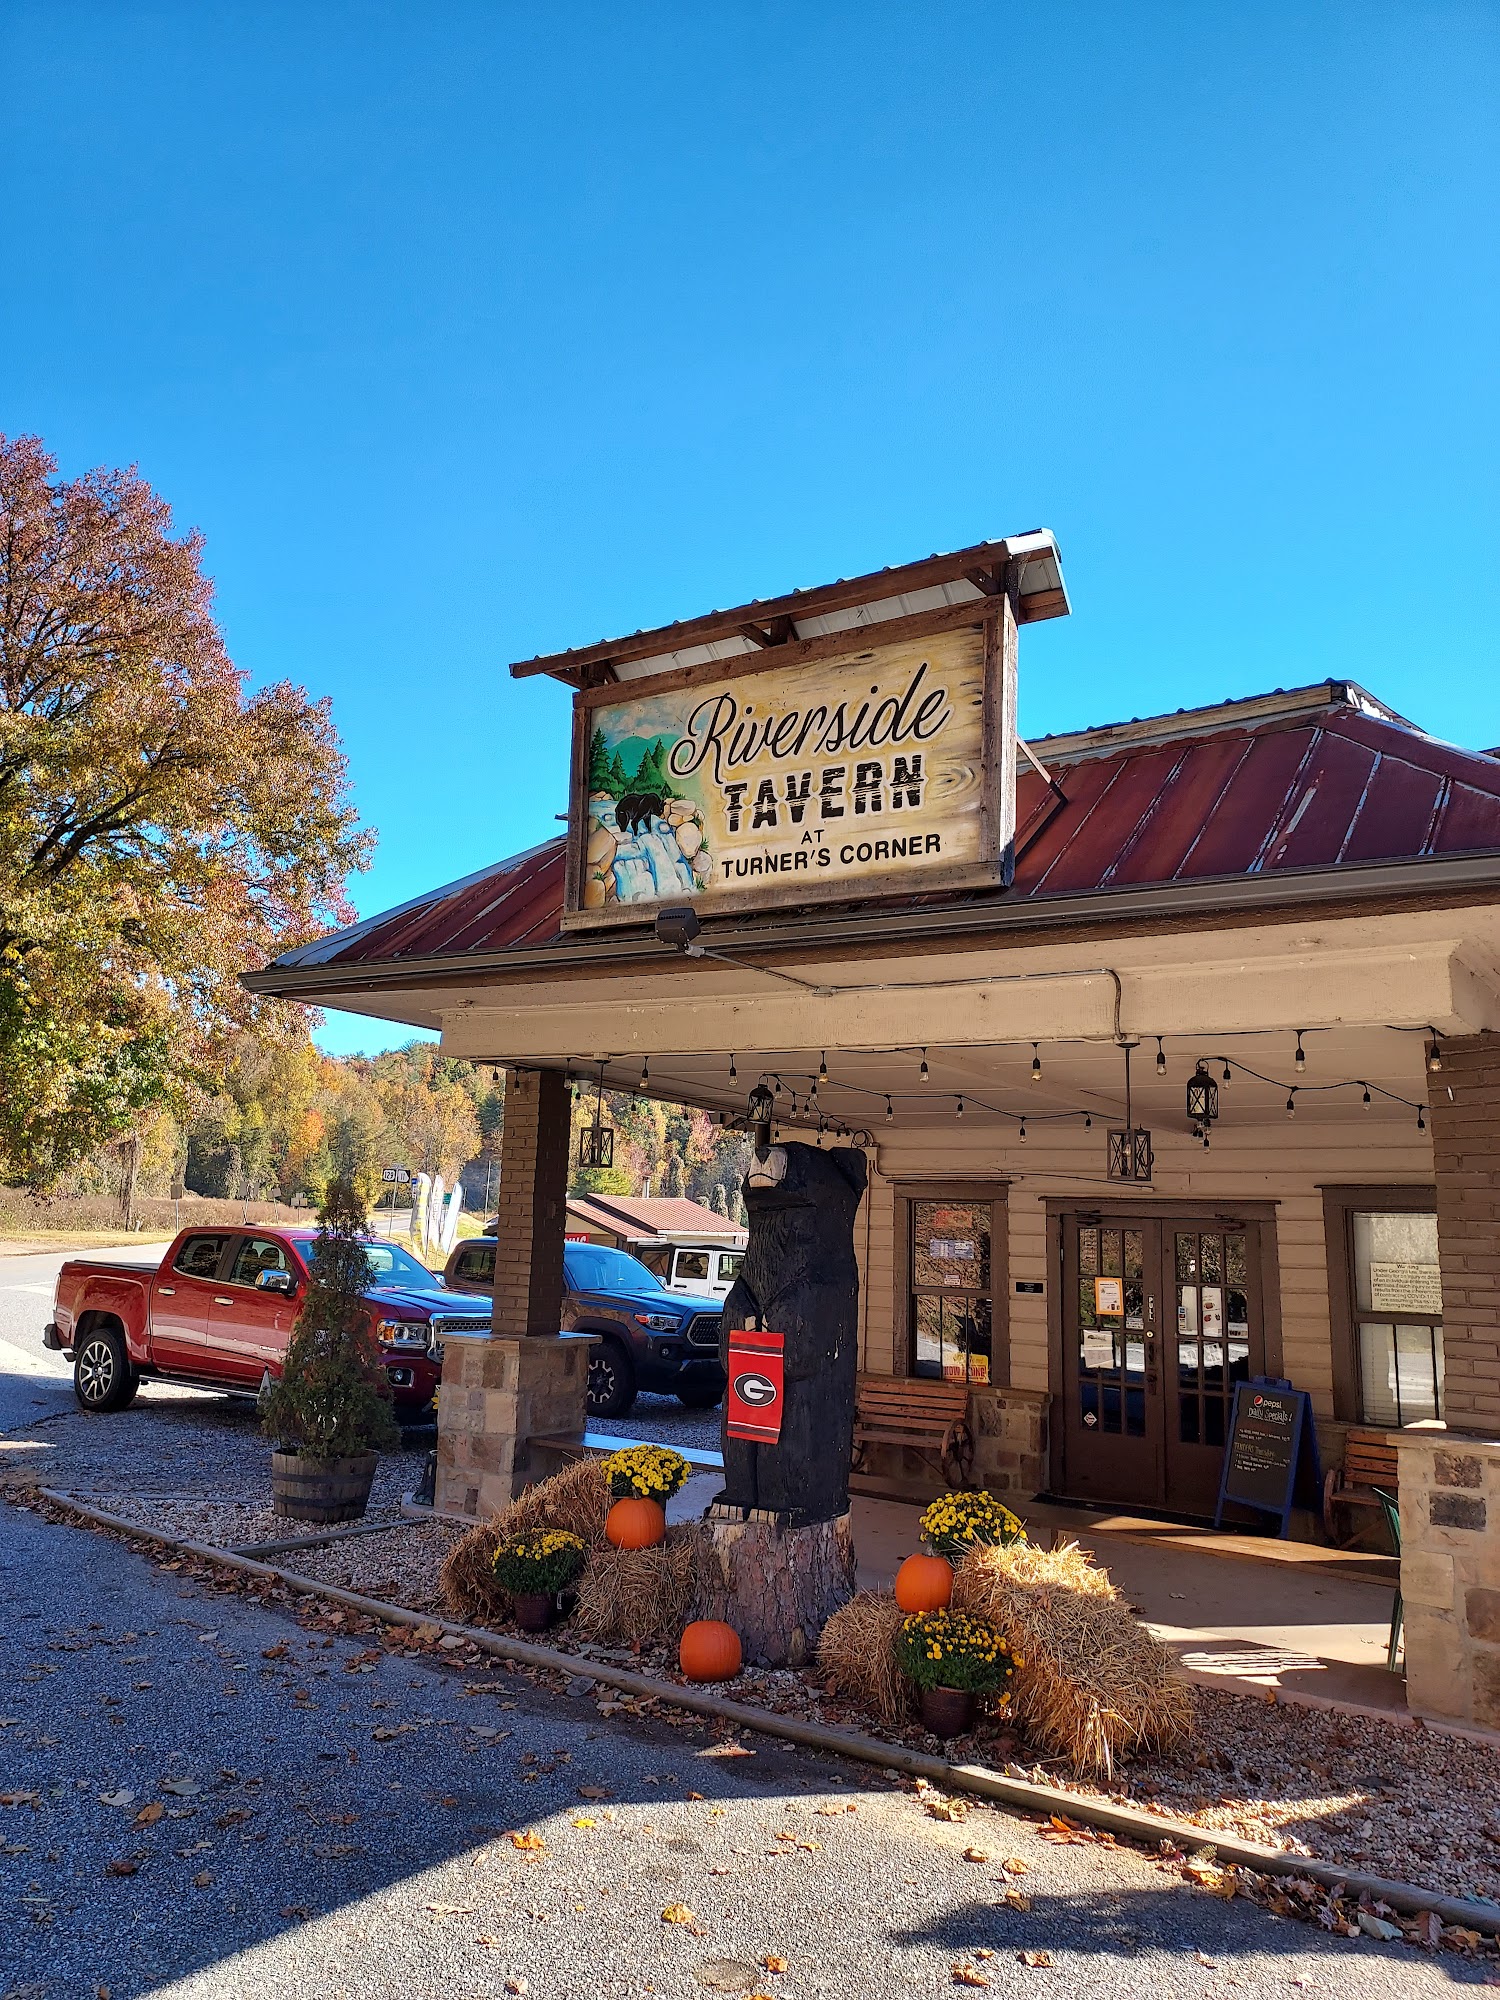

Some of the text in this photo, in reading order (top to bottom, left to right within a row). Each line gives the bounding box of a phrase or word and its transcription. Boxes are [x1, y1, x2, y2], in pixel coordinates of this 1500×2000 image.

[670, 662, 951, 784] Riverside
[721, 753, 926, 832] TAVERN
[800, 829, 823, 845] AT
[722, 833, 941, 879] TURNER'S CORNER
[1248, 1407, 1263, 1417] Daily
[1263, 1399, 1282, 1409] pepsi
